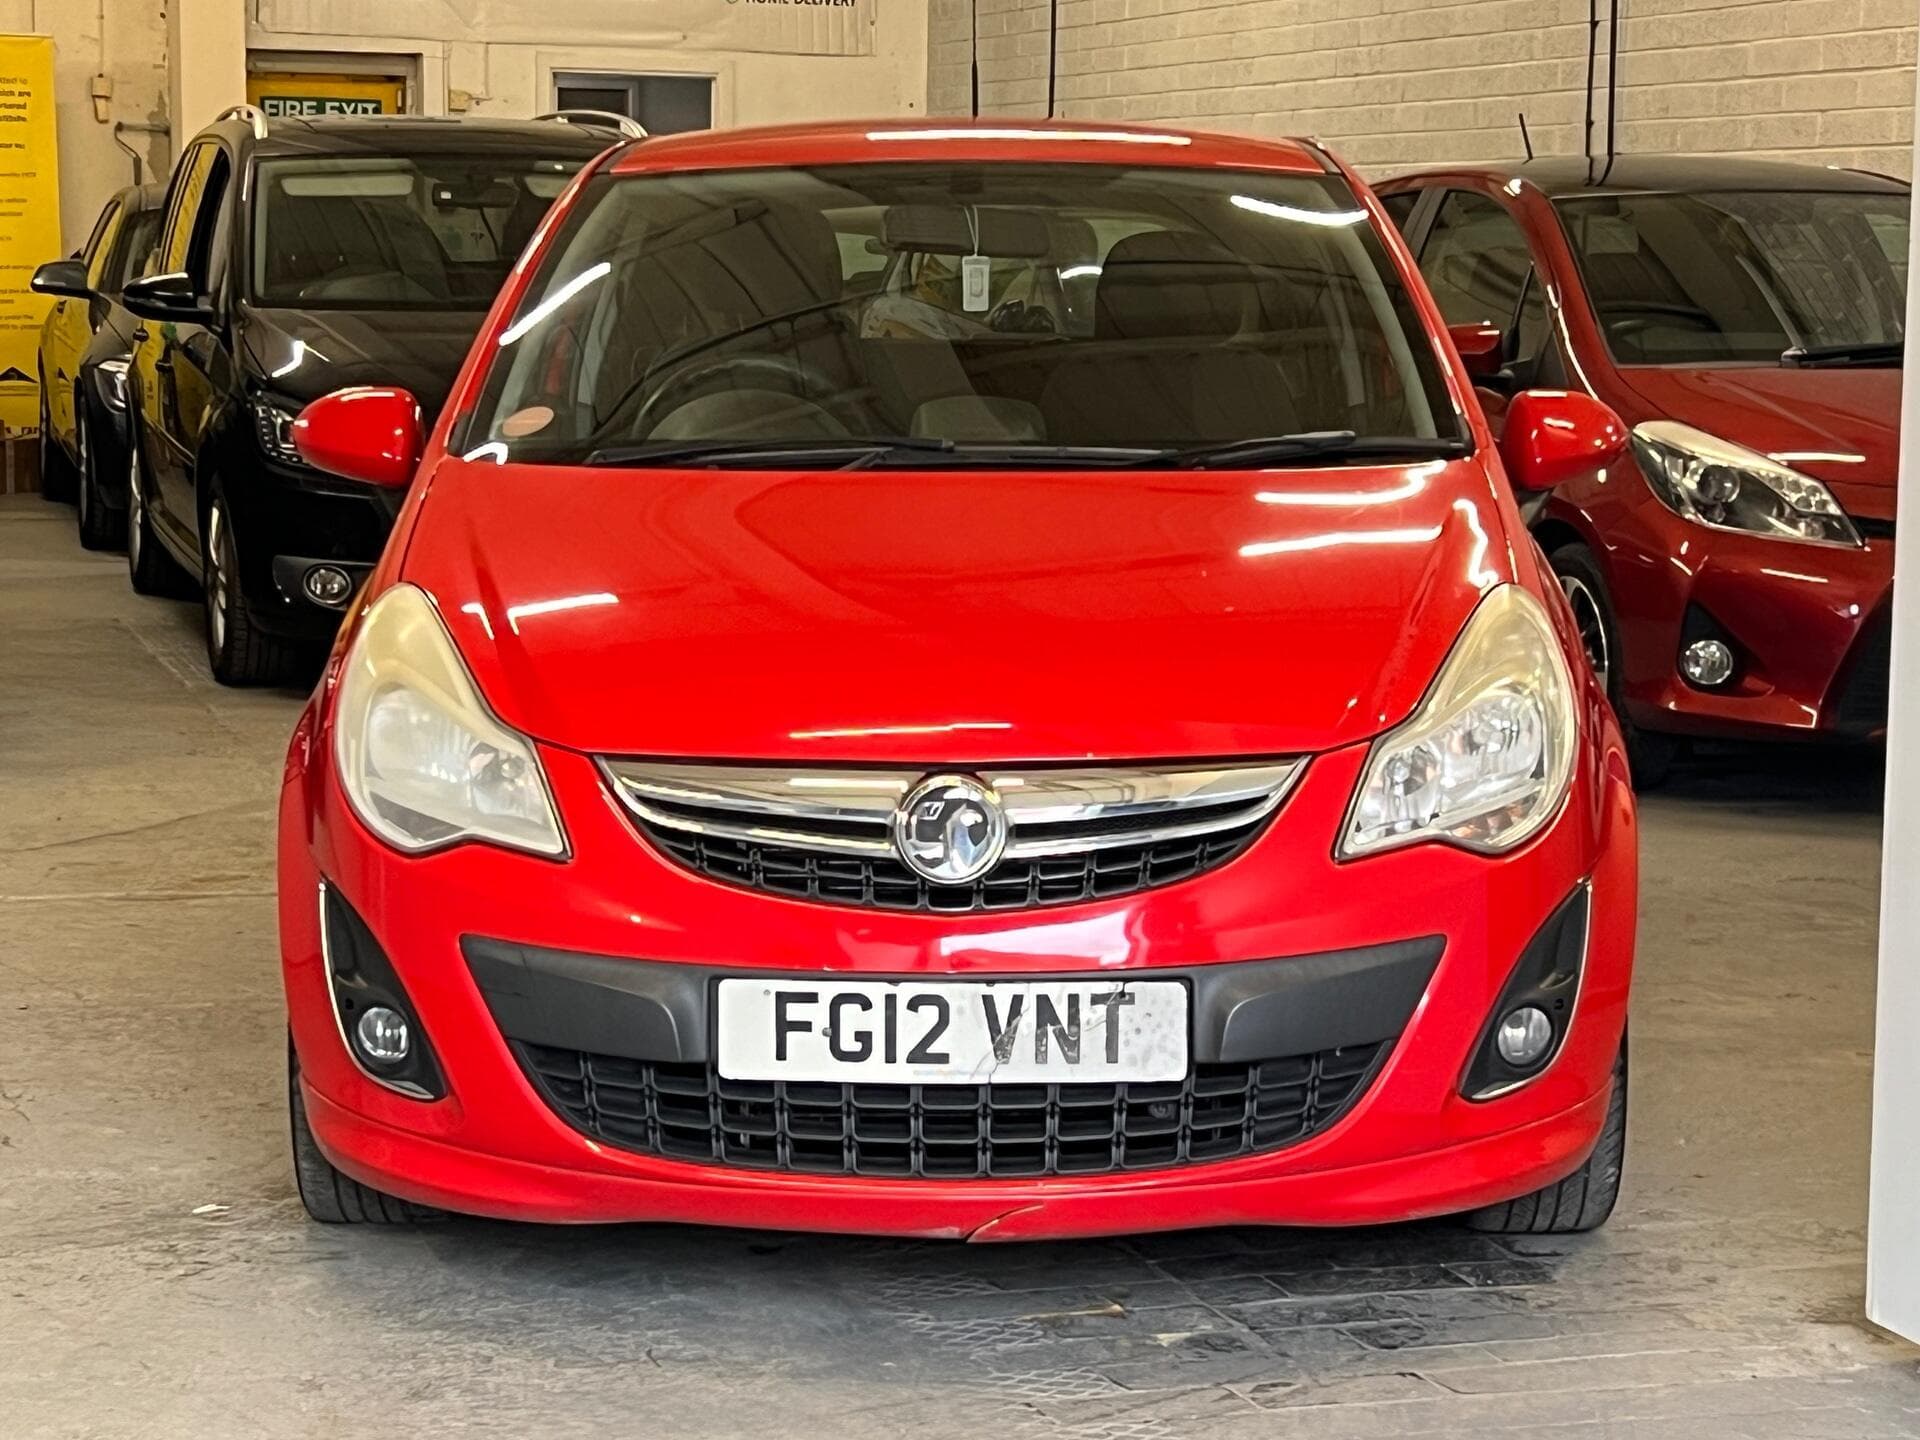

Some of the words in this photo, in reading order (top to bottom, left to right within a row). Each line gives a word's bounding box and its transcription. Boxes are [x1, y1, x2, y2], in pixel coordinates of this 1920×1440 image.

[264, 100, 318, 117] FIRE
[324, 101, 377, 116] EXIT
[775, 991, 951, 1065] FG12
[981, 992, 1136, 1065] VNT
